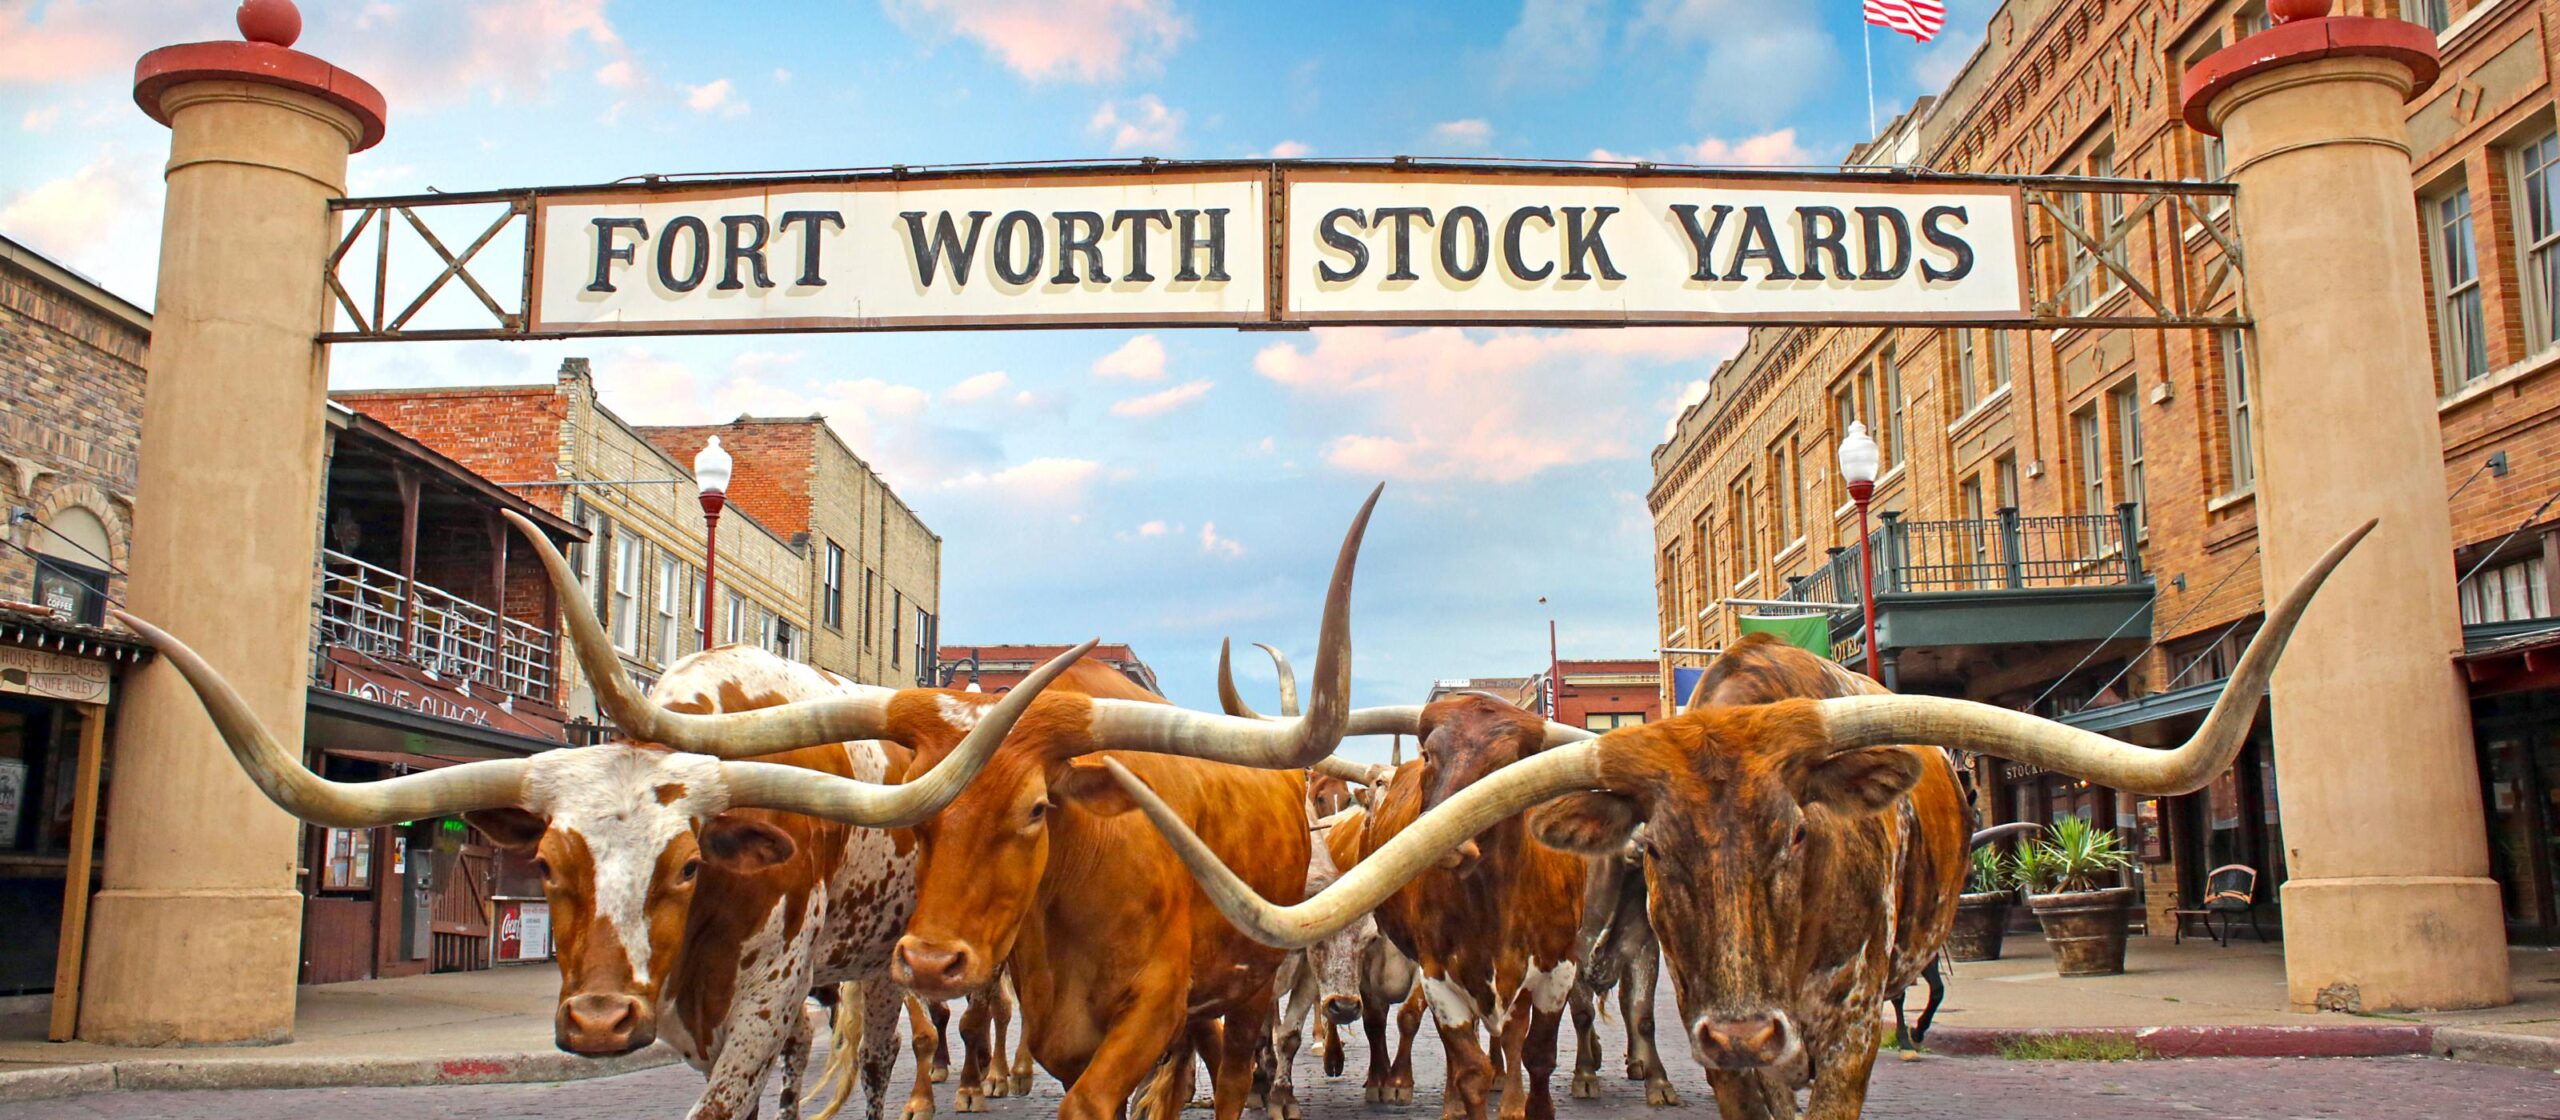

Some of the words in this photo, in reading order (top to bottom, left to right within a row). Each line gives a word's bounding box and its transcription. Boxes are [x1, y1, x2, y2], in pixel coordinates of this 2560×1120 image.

[587, 209, 846, 293] FORT
[899, 207, 1232, 287] WORTH
[1317, 204, 1628, 283] STOCK
[1669, 203, 1975, 284] YARDS
[47, 599, 73, 611] COFFEE
[2, 649, 39, 668] HOUSE
[44, 656, 59, 671] OF
[62, 659, 104, 678] BLADES
[34, 675, 63, 690] KNIFE
[66, 680, 94, 695] ALLEY
